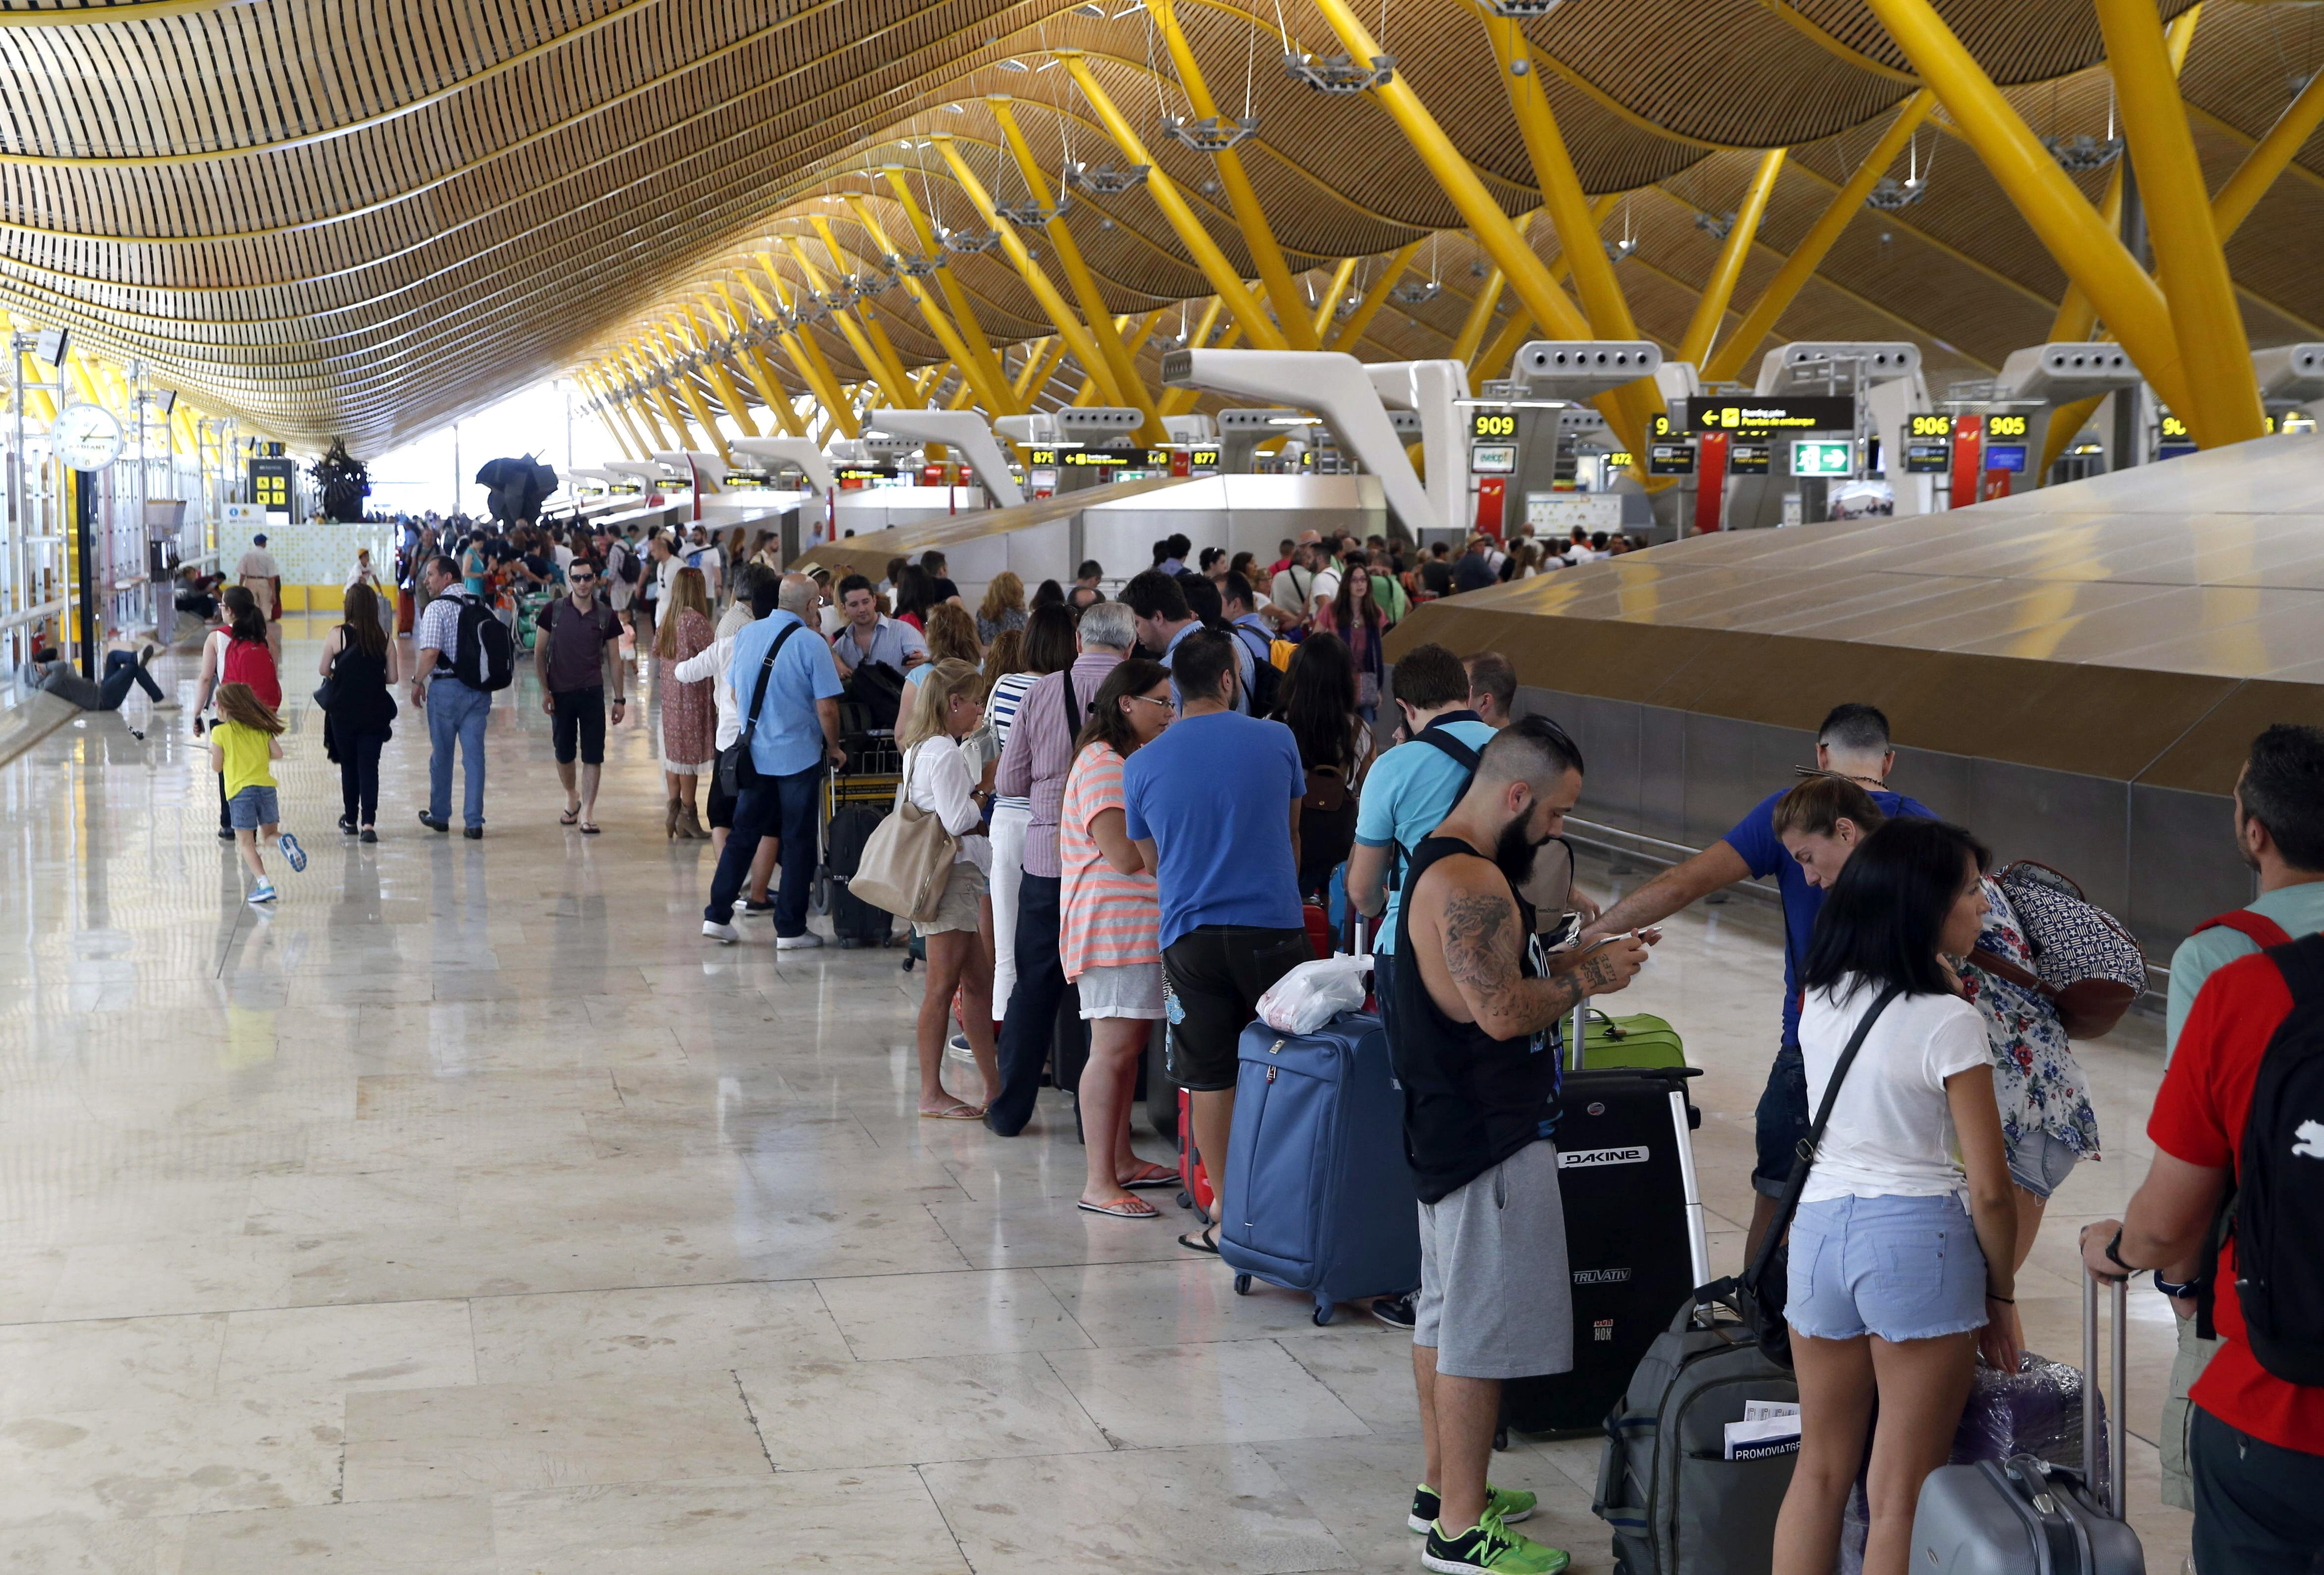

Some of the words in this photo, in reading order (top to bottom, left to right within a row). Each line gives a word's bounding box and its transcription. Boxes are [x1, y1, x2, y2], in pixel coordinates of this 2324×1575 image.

[1477, 417, 1514, 435] 909
[1913, 417, 1950, 435] 906
[1990, 417, 2026, 435] 905
[1194, 452, 1216, 464] 877
[1565, 1150, 1641, 1164] DAKINE
[1573, 1269, 1630, 1282] TRUVATIV
[1464, 1539, 1504, 1567] N
